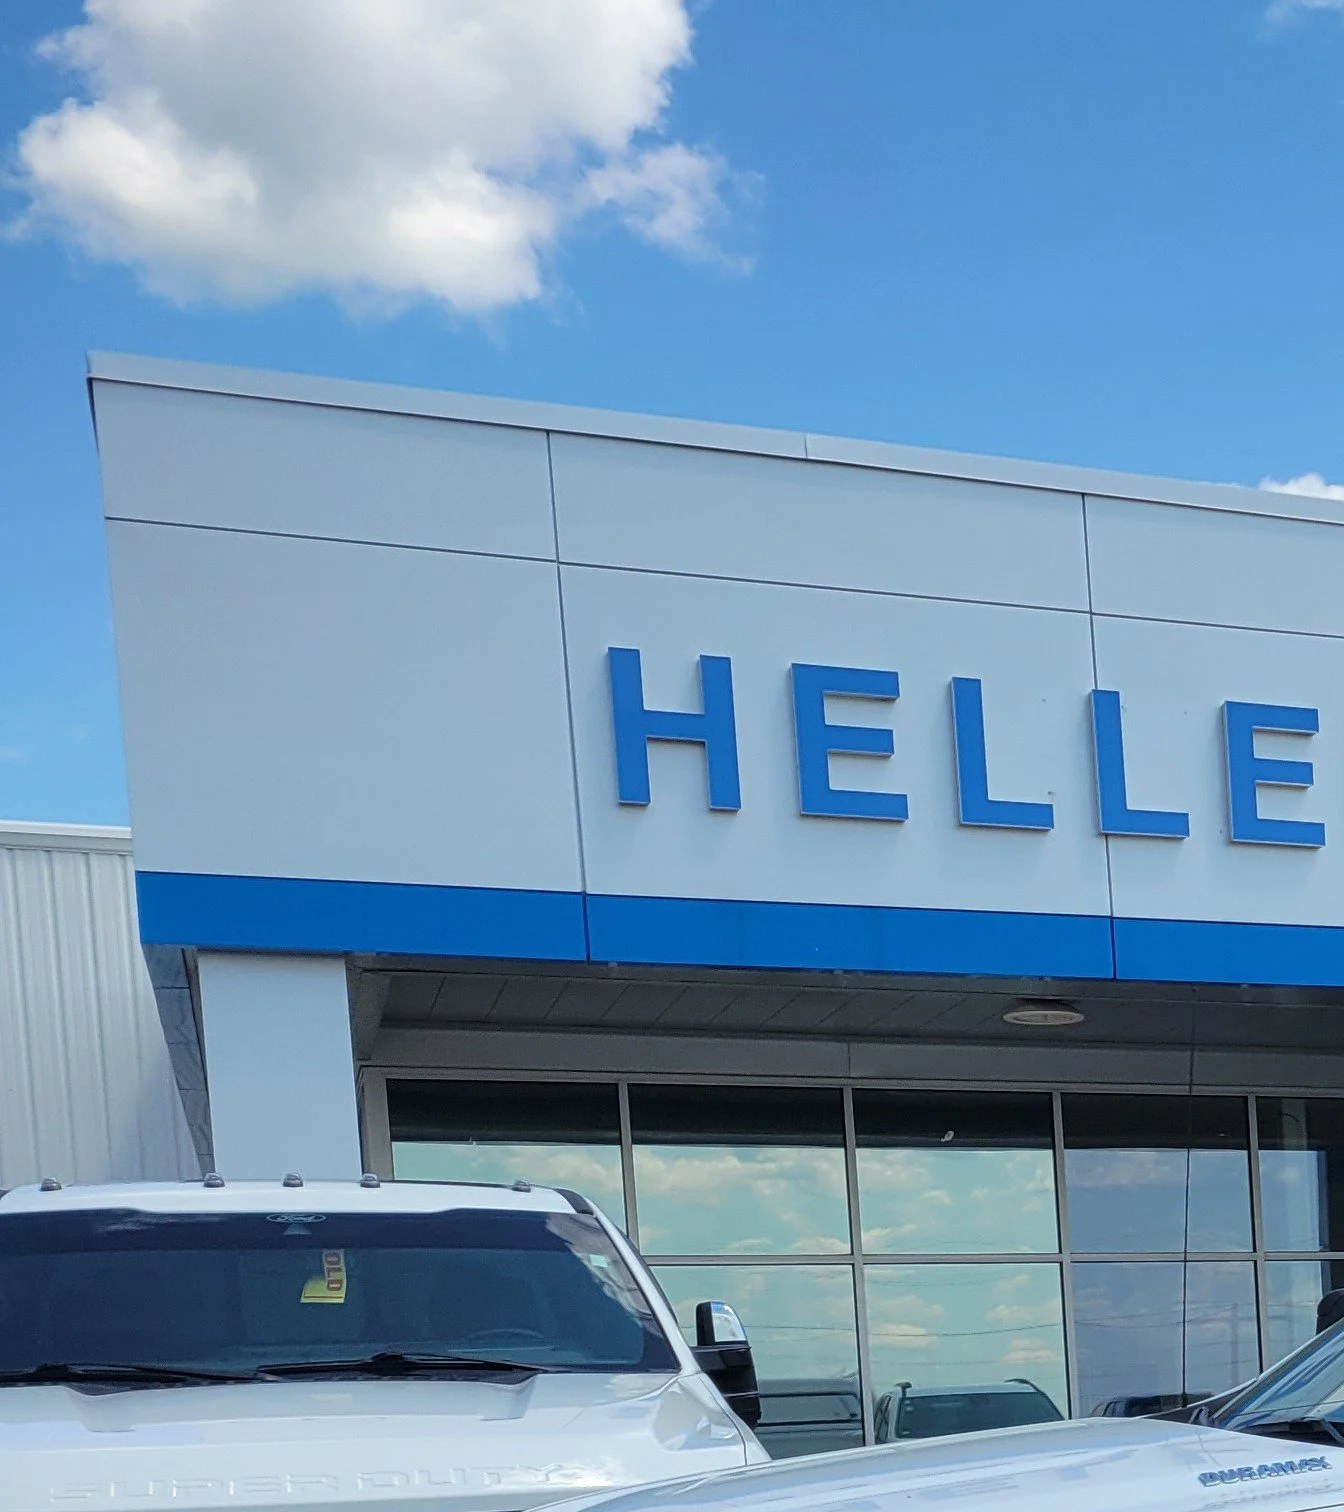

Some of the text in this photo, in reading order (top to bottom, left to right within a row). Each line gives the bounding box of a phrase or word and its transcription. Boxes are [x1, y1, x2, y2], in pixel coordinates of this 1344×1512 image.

[325, 1252, 342, 1291] OLD
[50, 1463, 564, 1501] SUPER DUTY
[1198, 1456, 1332, 1487] DURAMAX
